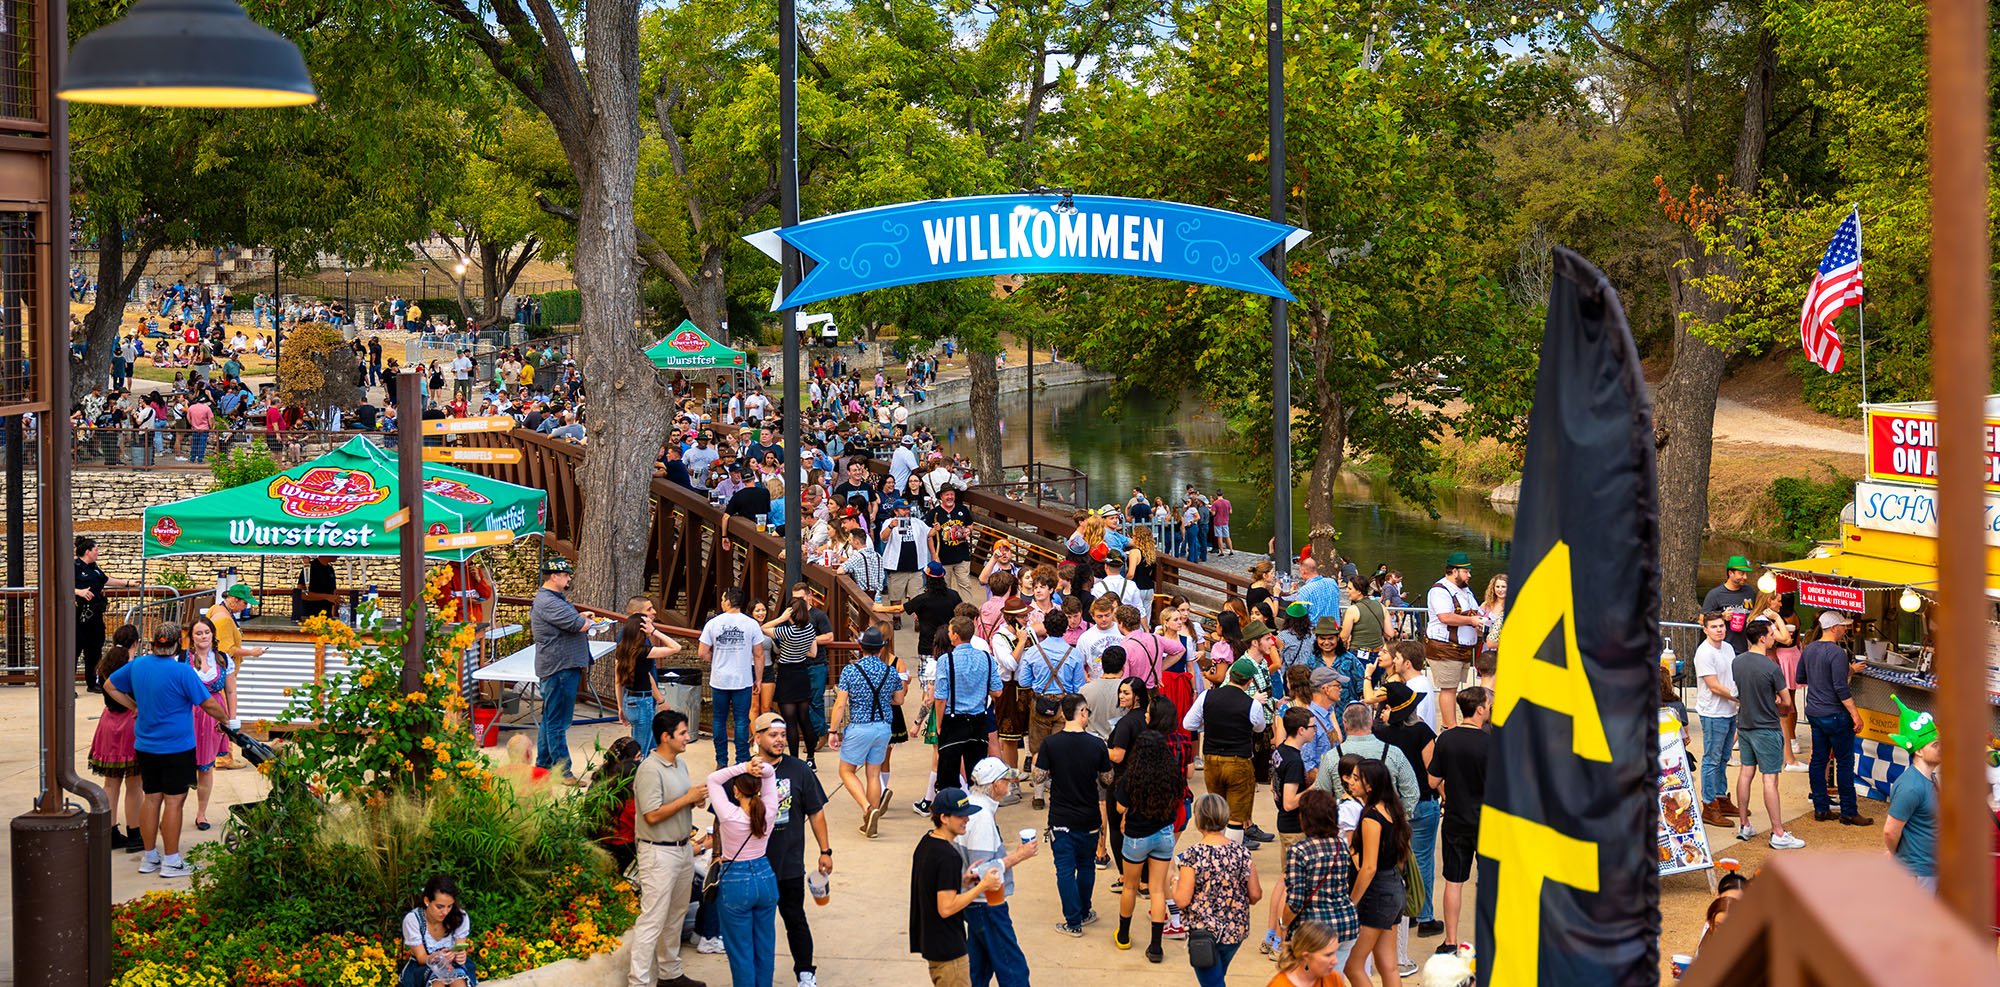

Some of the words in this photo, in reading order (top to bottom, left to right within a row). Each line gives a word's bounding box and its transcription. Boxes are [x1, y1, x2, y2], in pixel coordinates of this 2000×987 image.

[922, 213, 1164, 265] WILLKOMMEN
[667, 355, 716, 365] Wurstfest
[1893, 447, 1921, 475] ON
[281, 483, 380, 502] Wurstfest
[229, 518, 375, 547] Wurstfest
[1807, 586, 1826, 595] ORDER
[1826, 589, 1857, 599] SCHNITZELS
[1832, 598, 1848, 606] ITEMS
[1849, 600, 1862, 608] HERE
